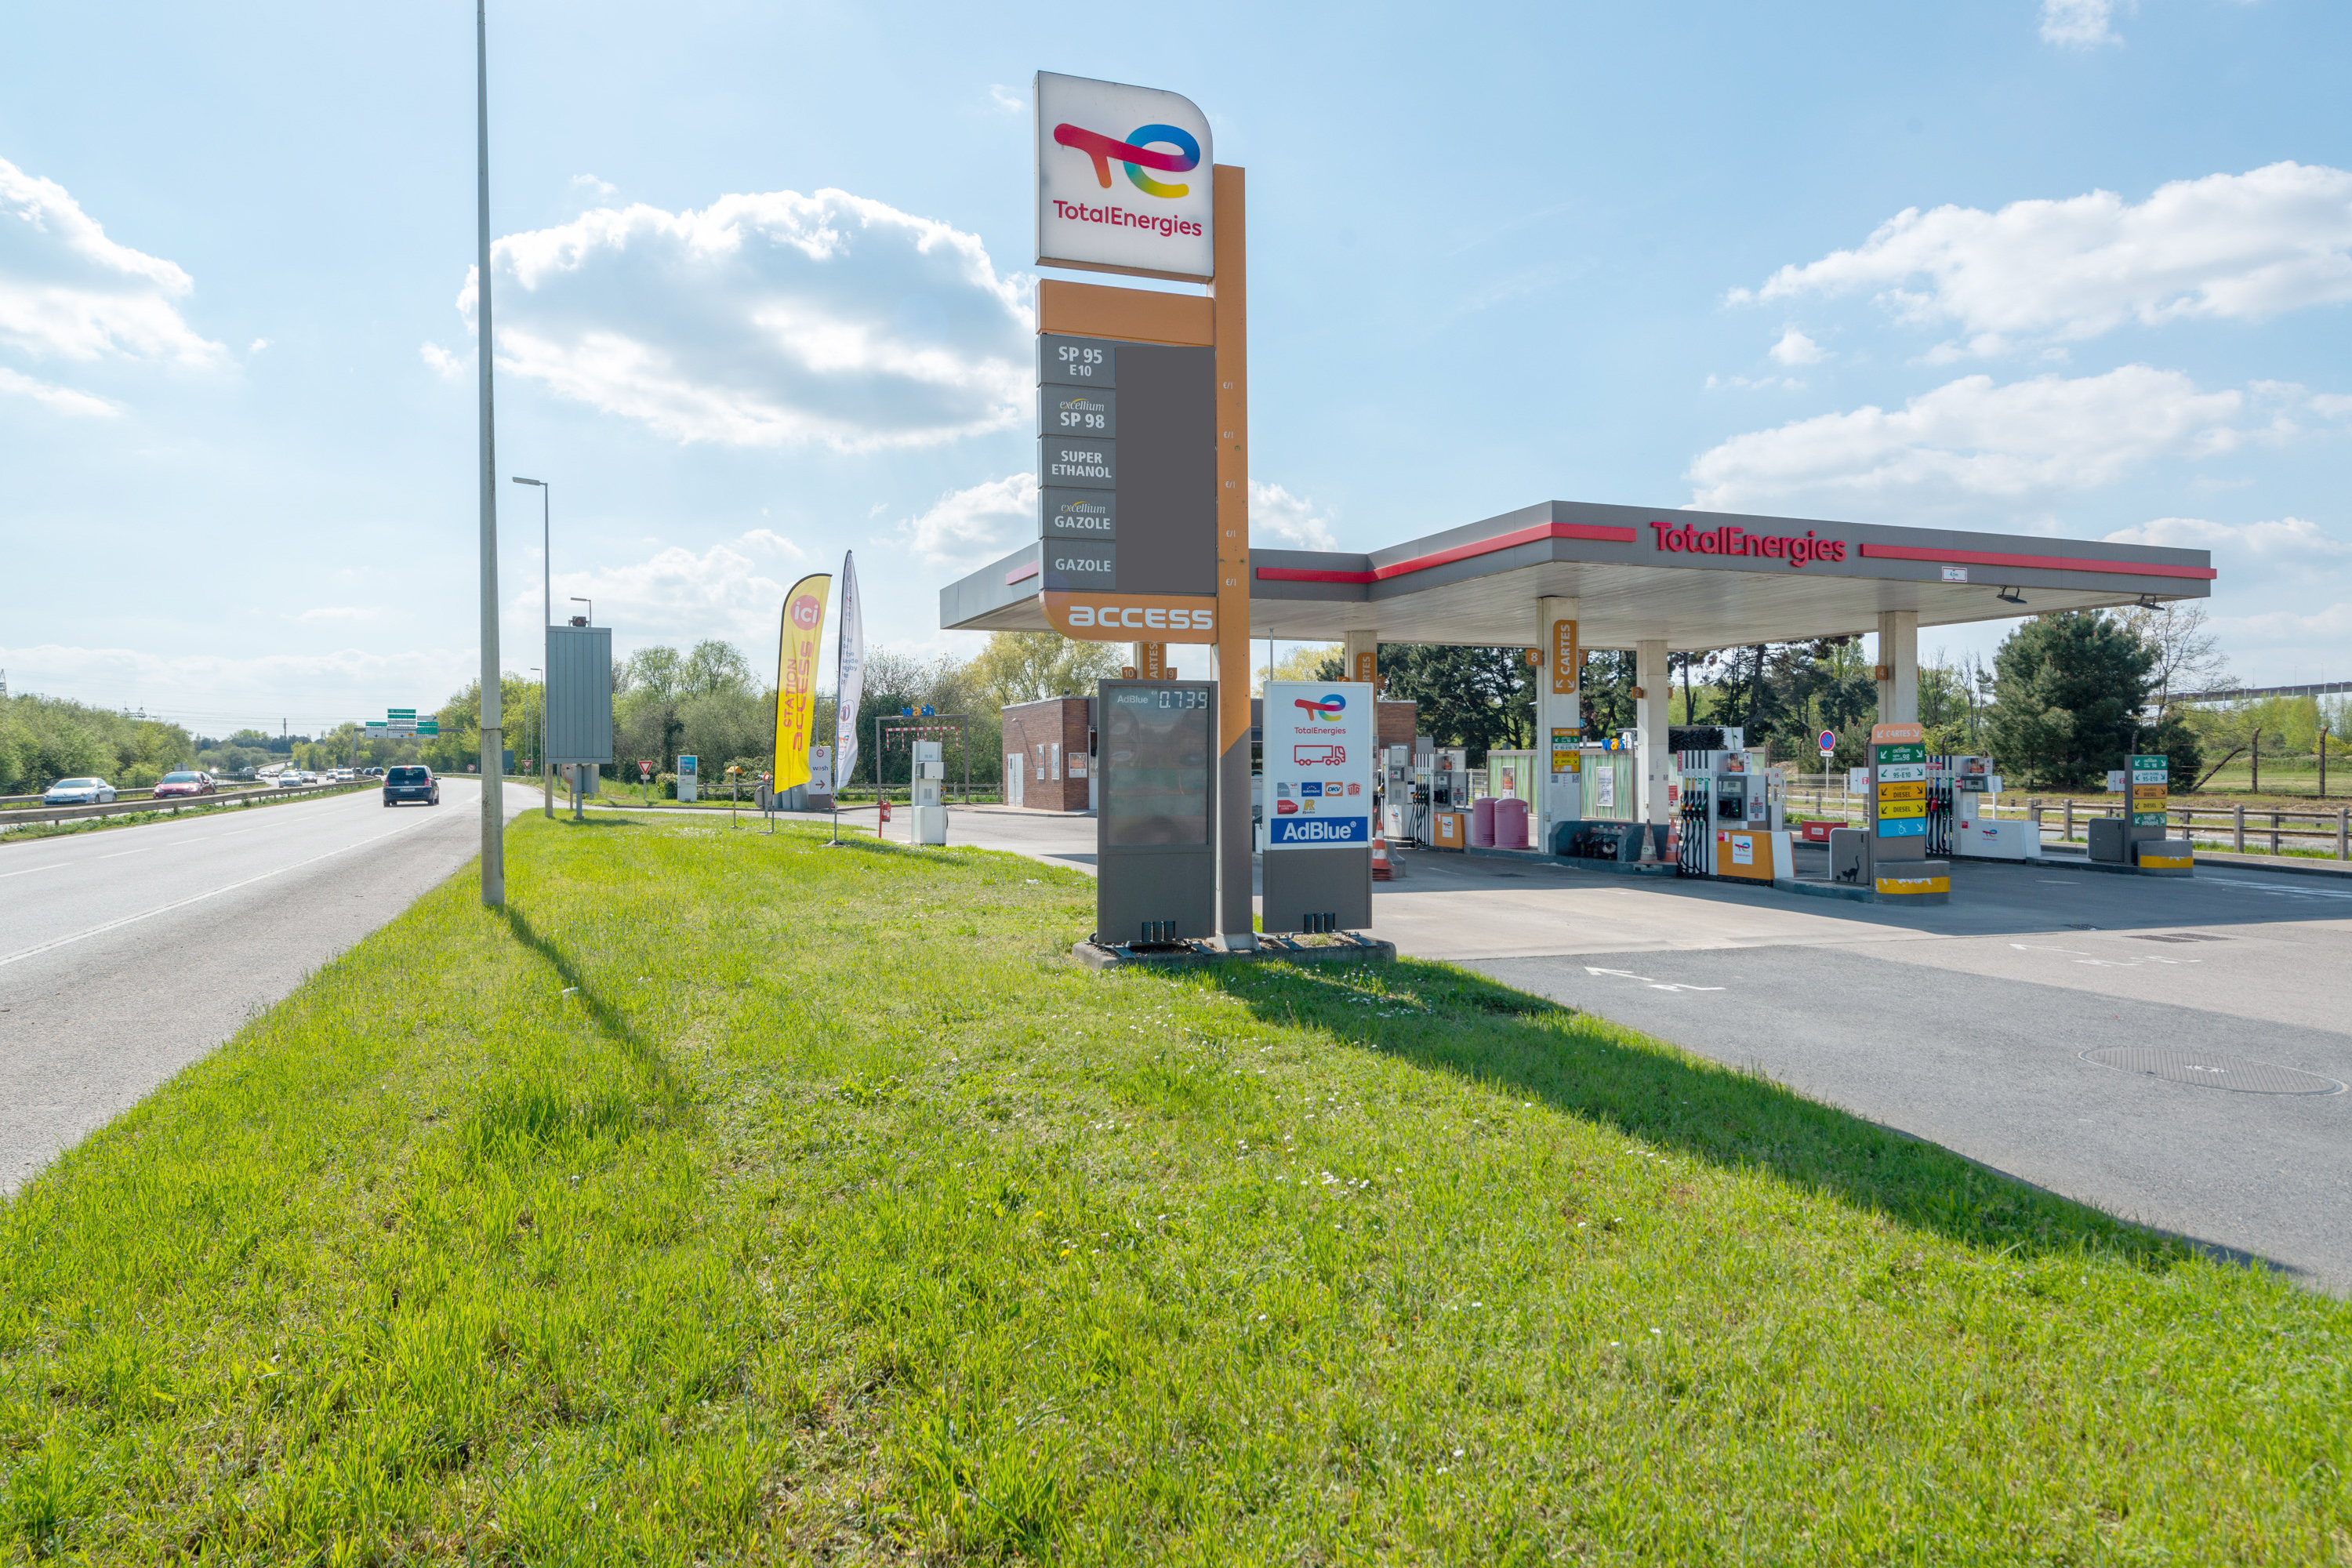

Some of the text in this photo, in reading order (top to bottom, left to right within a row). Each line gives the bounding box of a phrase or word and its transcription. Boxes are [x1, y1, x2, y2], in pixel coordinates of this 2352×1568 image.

[1053, 200, 1202, 237] TotalEnergies
[1058, 346, 1103, 364] SP 95
[1059, 399, 1105, 412] excellium
[1060, 412, 1105, 429] SP 98
[1061, 450, 1102, 464] SUPER
[1051, 463, 1112, 478] ETHANOL
[1061, 502, 1105, 514] excellium
[1054, 515, 1111, 530] GAZOLE
[1650, 521, 1847, 568] TotalEnergies
[1054, 558, 1112, 572] GAZOLE
[794, 601, 818, 624] ici
[1531, 652, 1538, 662] 8
[1560, 624, 1570, 675] CARTES
[1149, 644, 1158, 679] ARTES
[1362, 656, 1370, 681] RTES
[1124, 669, 1134, 678] 10
[1168, 670, 1174, 678] 9
[783, 659, 797, 728] STATION
[1117, 695, 1148, 703] AdBlue
[1159, 691, 1208, 709] 0.739
[1635, 689, 1639, 697] 2
[902, 703, 935, 717] wash
[1294, 726, 1346, 736] TotalEnergies
[1347, 783, 1361, 795] UTA
